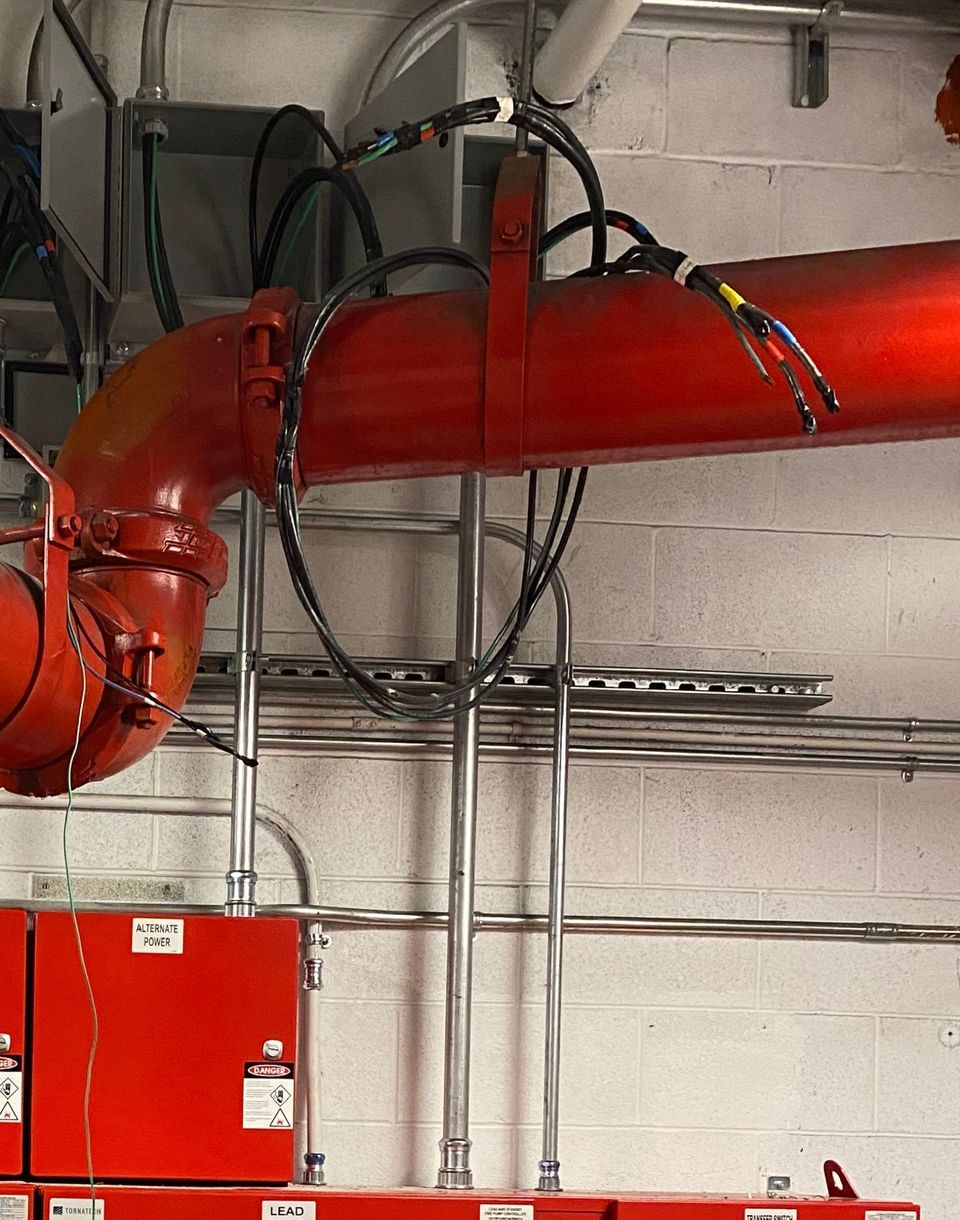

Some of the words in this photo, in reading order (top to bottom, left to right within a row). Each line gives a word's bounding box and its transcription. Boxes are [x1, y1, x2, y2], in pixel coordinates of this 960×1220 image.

[136, 924, 179, 933] ALTERNATE
[144, 937, 171, 947] POWER
[253, 1067, 286, 1075] DANGER
[270, 1206, 304, 1216] LEAD
